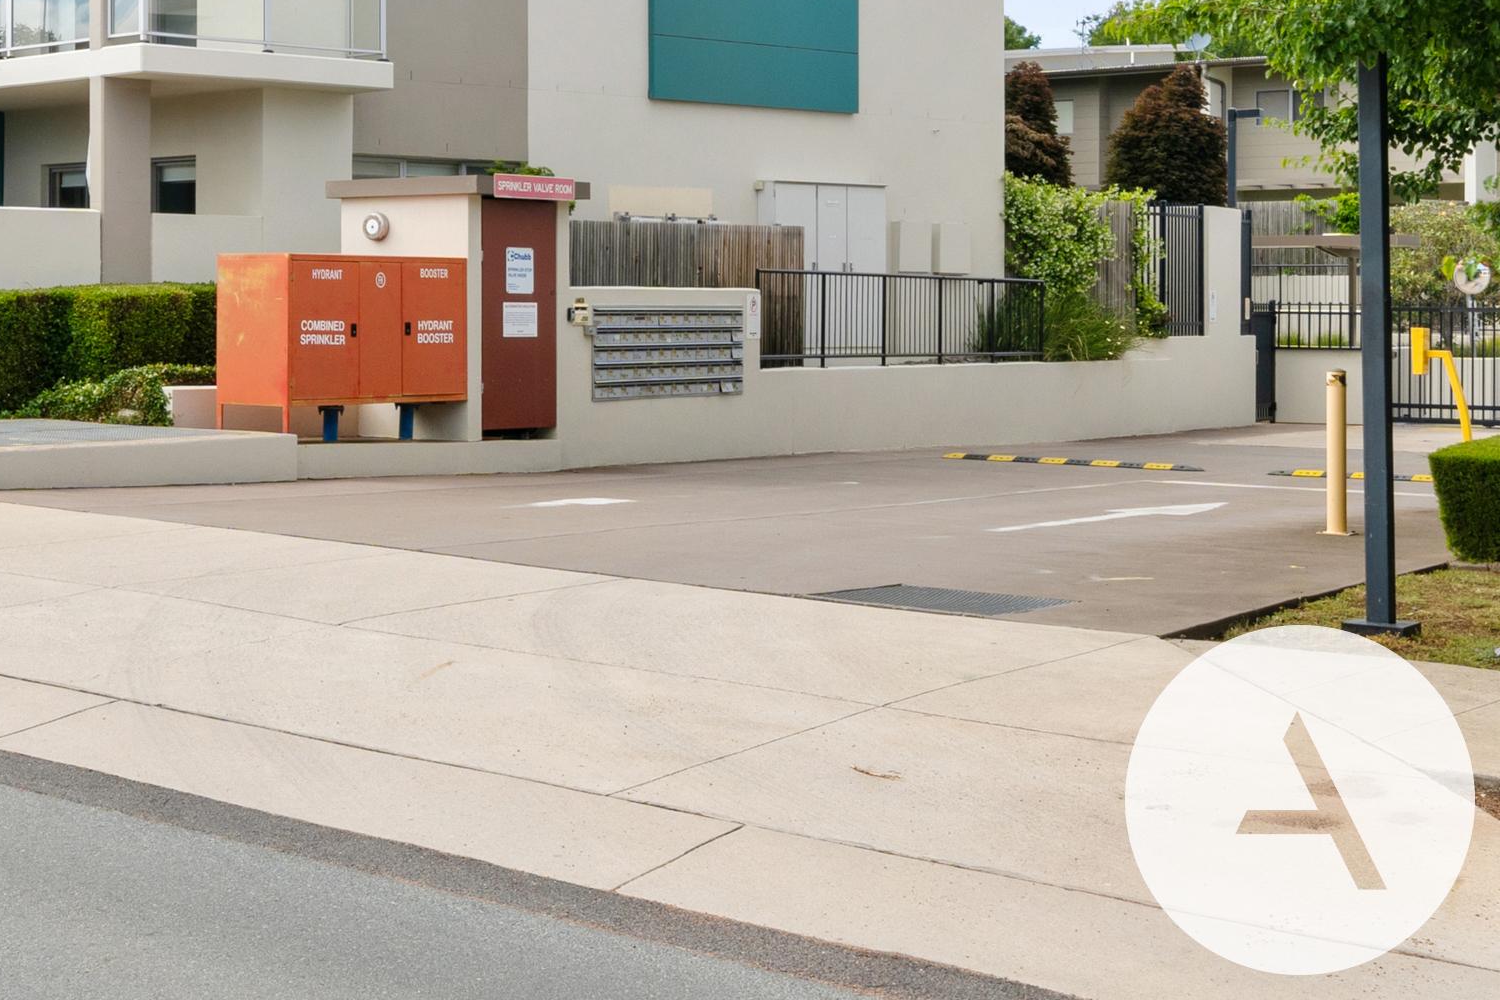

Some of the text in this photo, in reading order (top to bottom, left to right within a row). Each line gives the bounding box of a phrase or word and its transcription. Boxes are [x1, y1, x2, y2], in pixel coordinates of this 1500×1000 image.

[498, 180, 572, 194] SPRINKLER VALVE ROOM
[312, 269, 343, 280] HYDRANT
[420, 268, 448, 279] BOOSTER
[301, 320, 345, 332] COMBINED
[418, 320, 453, 331] HYDRANT
[300, 334, 346, 345] SPRINKLER
[417, 333, 454, 344] BOOSTER
